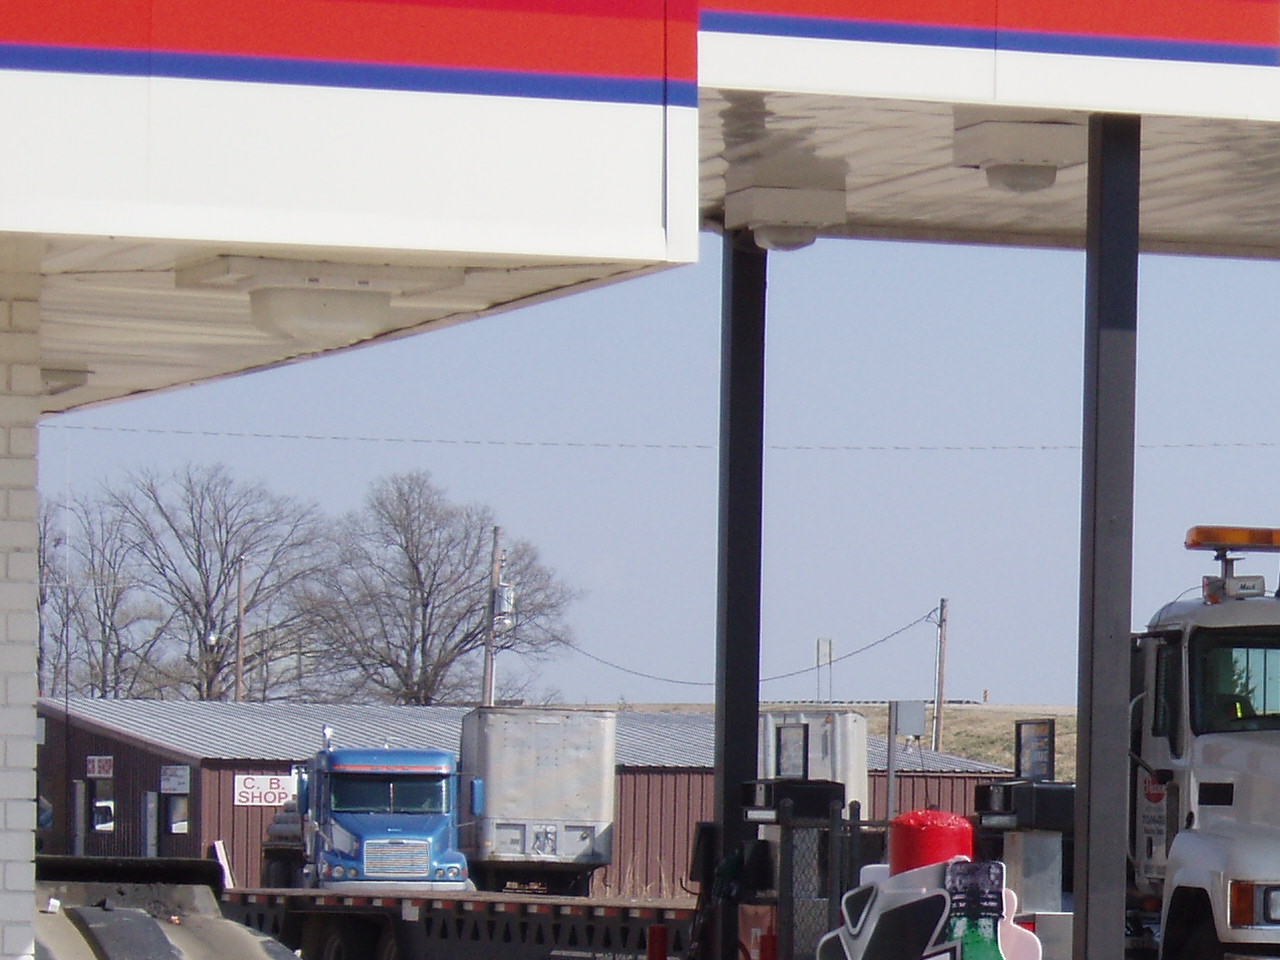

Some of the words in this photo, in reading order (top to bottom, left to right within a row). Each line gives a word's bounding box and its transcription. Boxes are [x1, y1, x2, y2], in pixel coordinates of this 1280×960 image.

[243, 777, 260, 790] C.
[269, 777, 285, 790] B.
[238, 791, 289, 804] SHOP
